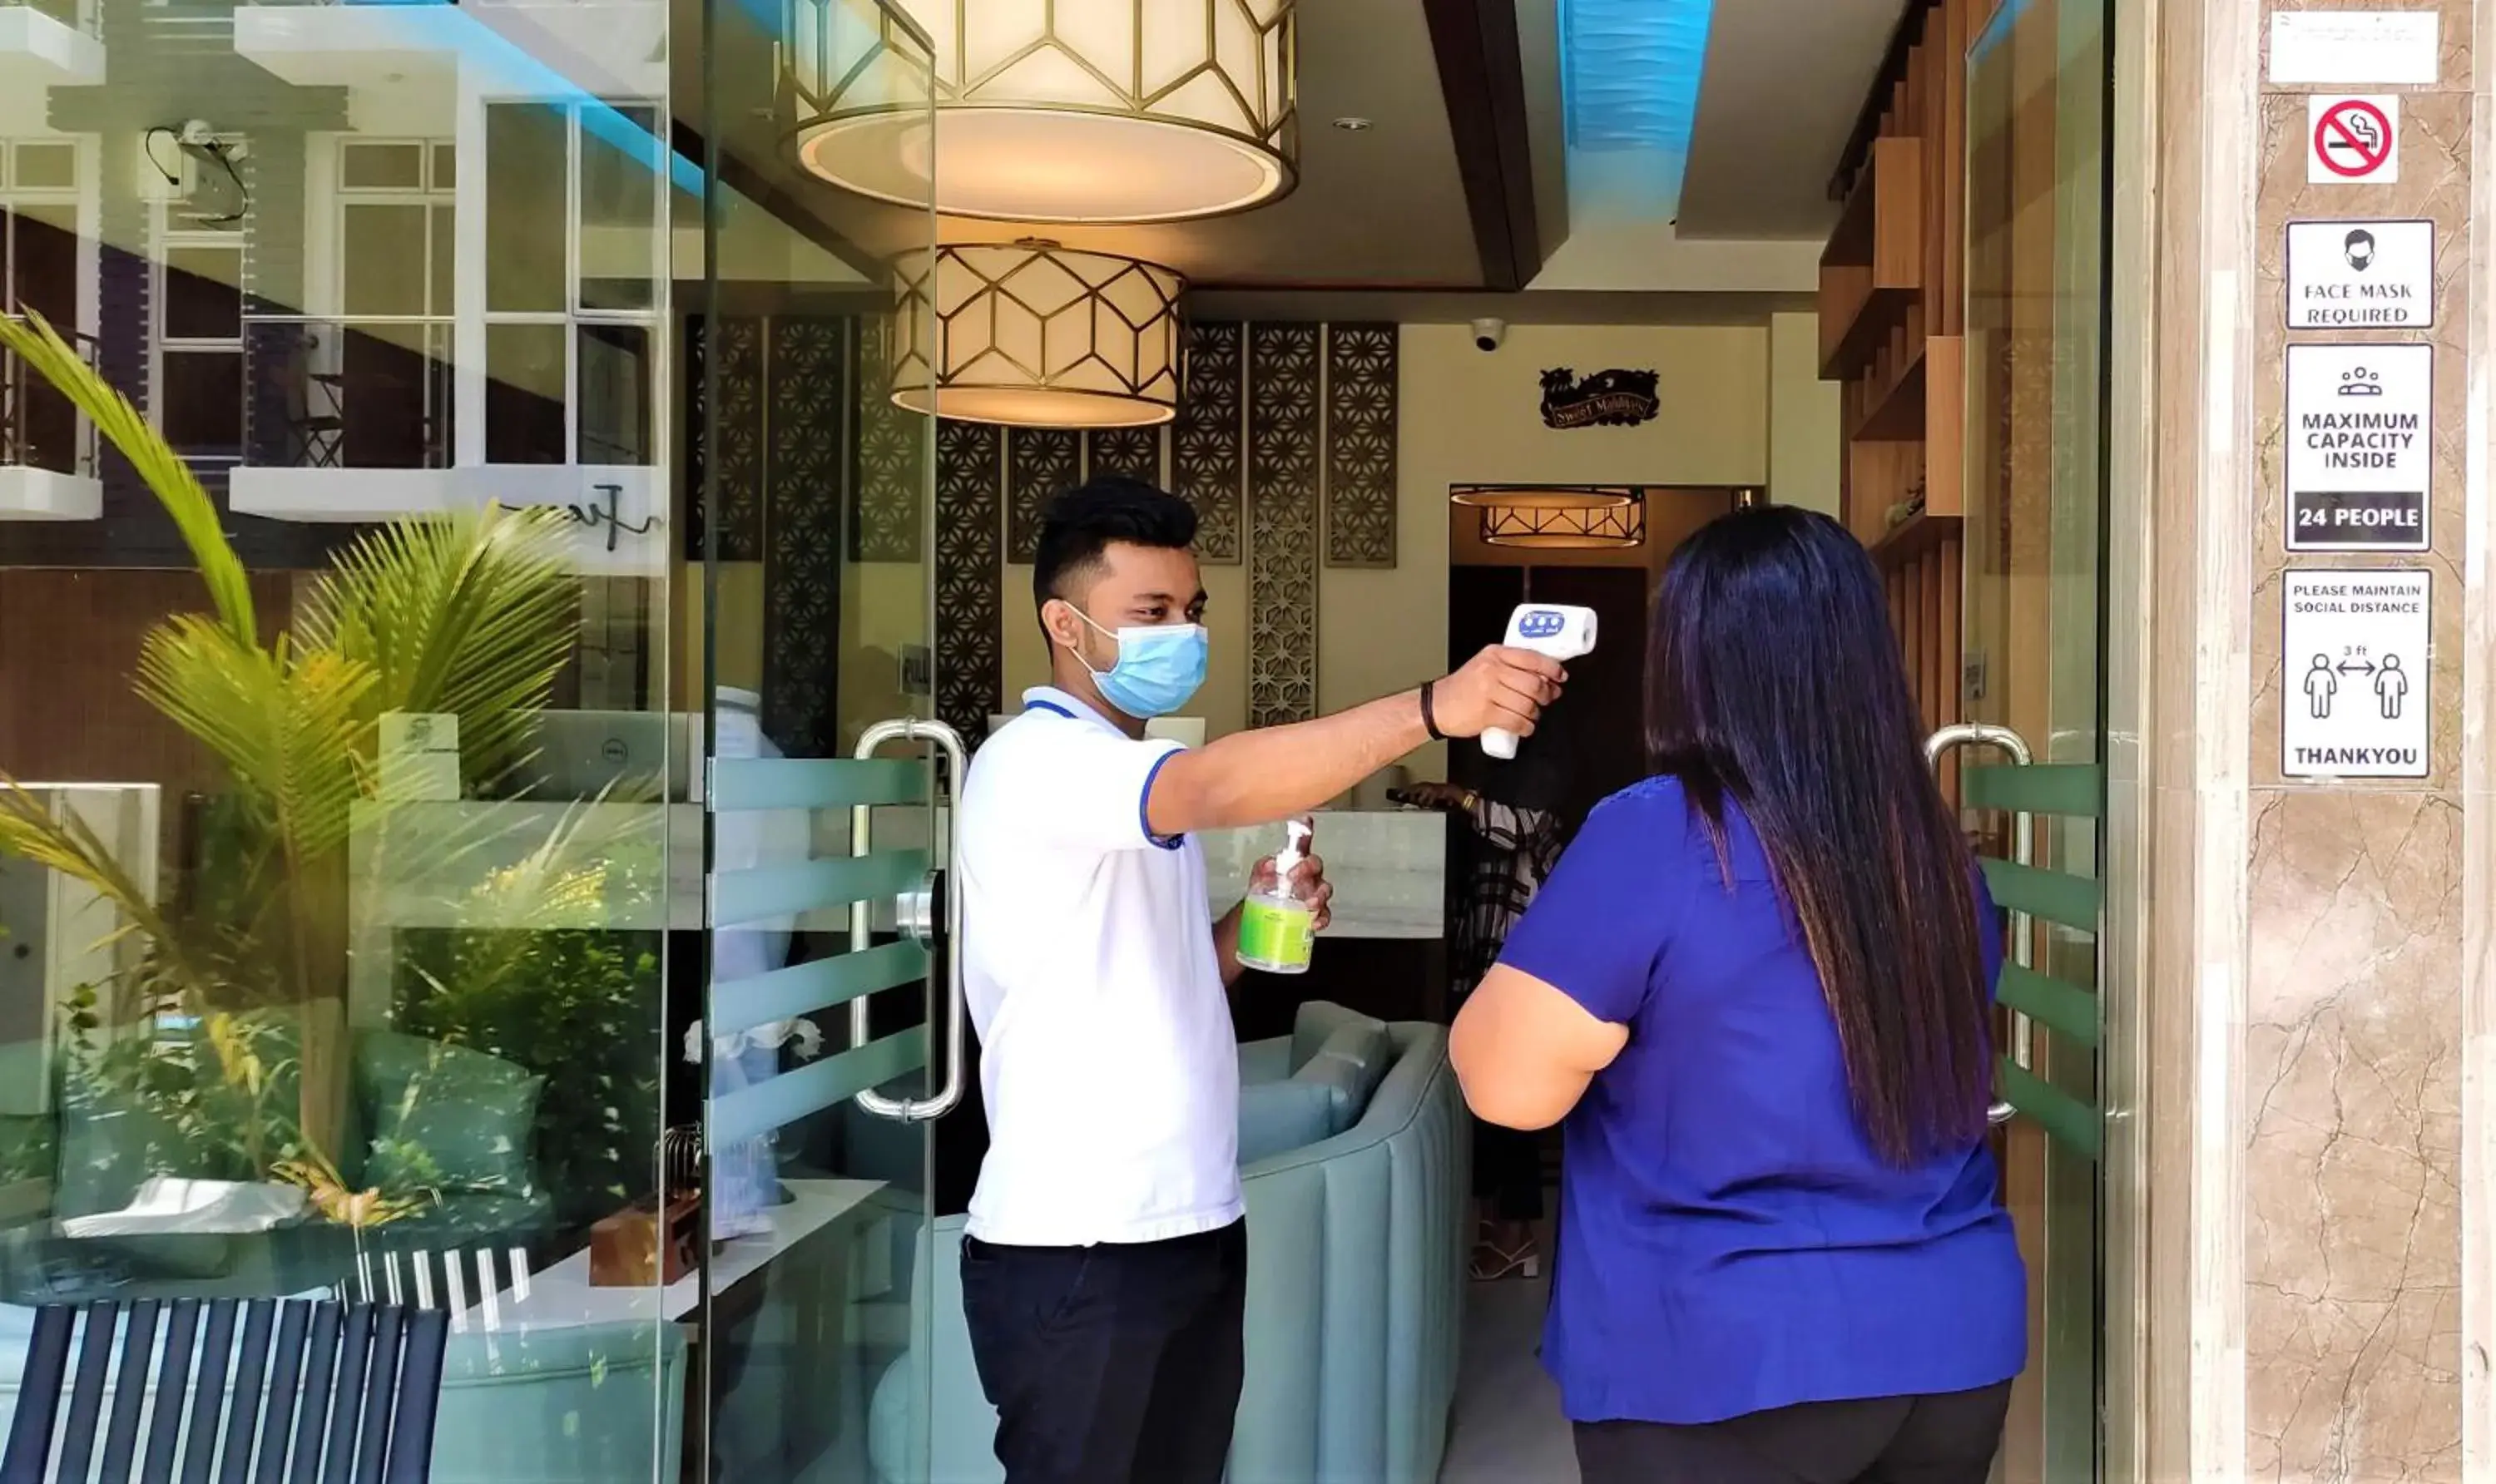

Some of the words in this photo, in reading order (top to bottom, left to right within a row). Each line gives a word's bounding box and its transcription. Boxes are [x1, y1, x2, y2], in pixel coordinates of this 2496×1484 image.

[2305, 284, 2351, 299] FACE
[2360, 284, 2412, 299] MASK
[2307, 307, 2409, 324] REQUIRED
[2302, 413, 2419, 430] MAXIMUM
[2306, 432, 2414, 449] CAPACITY
[2325, 453, 2397, 468] INSIDE
[2299, 508, 2327, 527] 24
[2335, 508, 2419, 527] PEOPLE
[2293, 585, 2348, 596] PLEASE
[2352, 585, 2421, 596] MAINTAIN
[2294, 601, 2346, 613] SOCIAL
[2350, 601, 2419, 613] DISTANCE
[2344, 646, 2352, 656] 3
[2355, 645, 2368, 656] ft
[2295, 747, 2417, 765] THANKYOU
